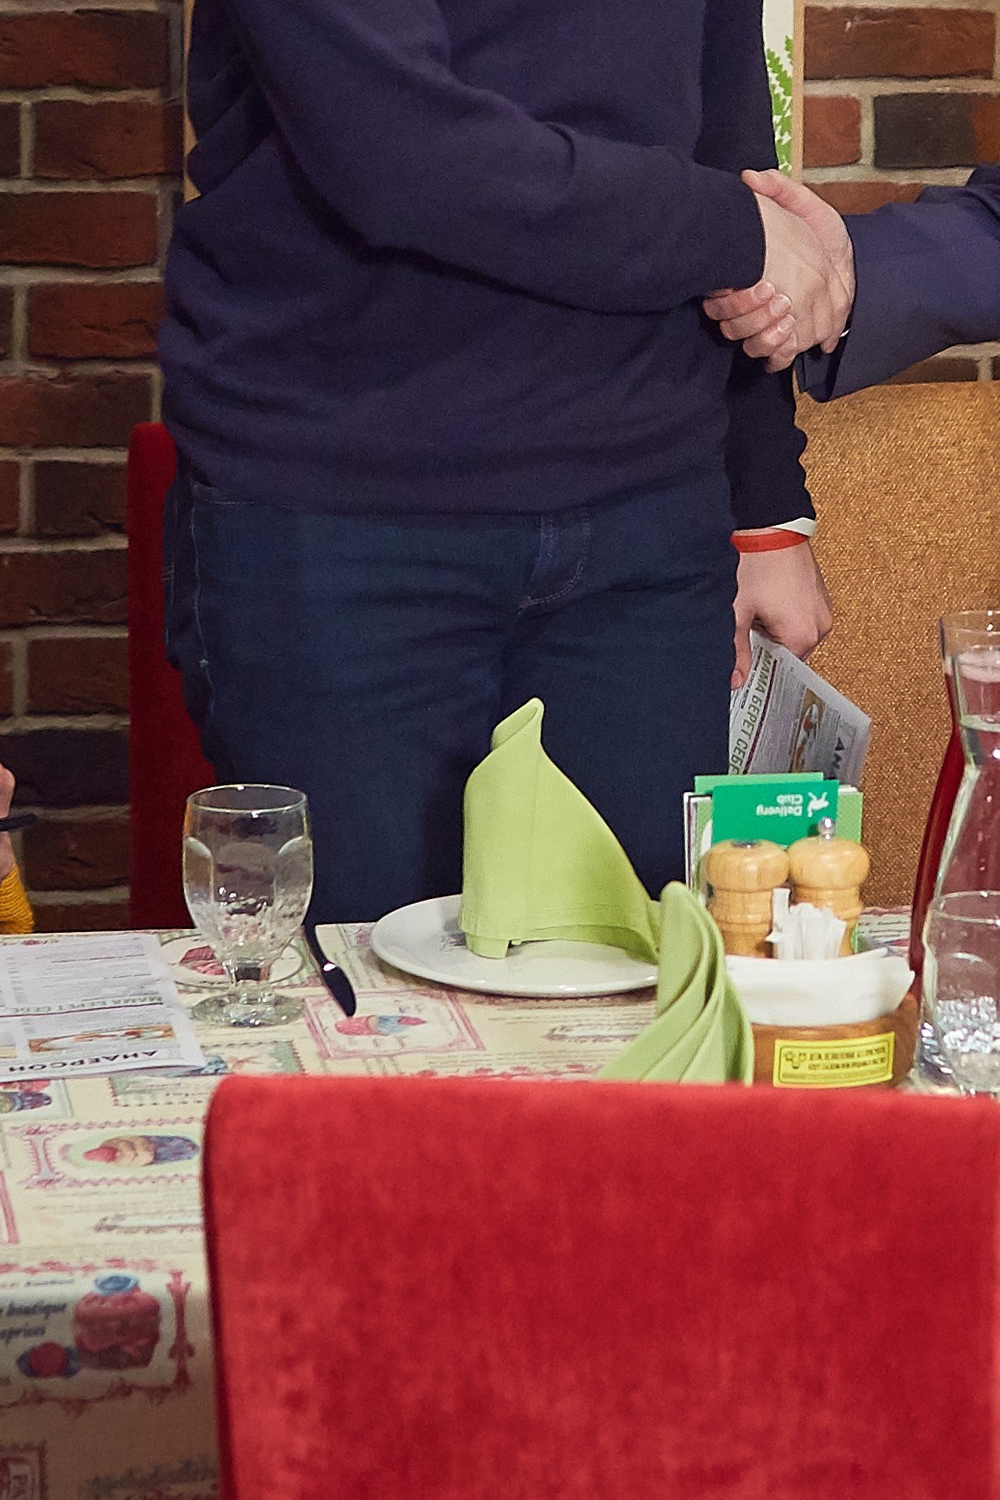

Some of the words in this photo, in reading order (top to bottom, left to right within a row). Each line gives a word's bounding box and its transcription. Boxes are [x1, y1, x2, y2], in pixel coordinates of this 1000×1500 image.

[755, 650, 773, 694] МАМА
[740, 694, 763, 739] БЕРЕТ
[756, 803, 803, 817] Delivery
[776, 793, 804, 805] Club
